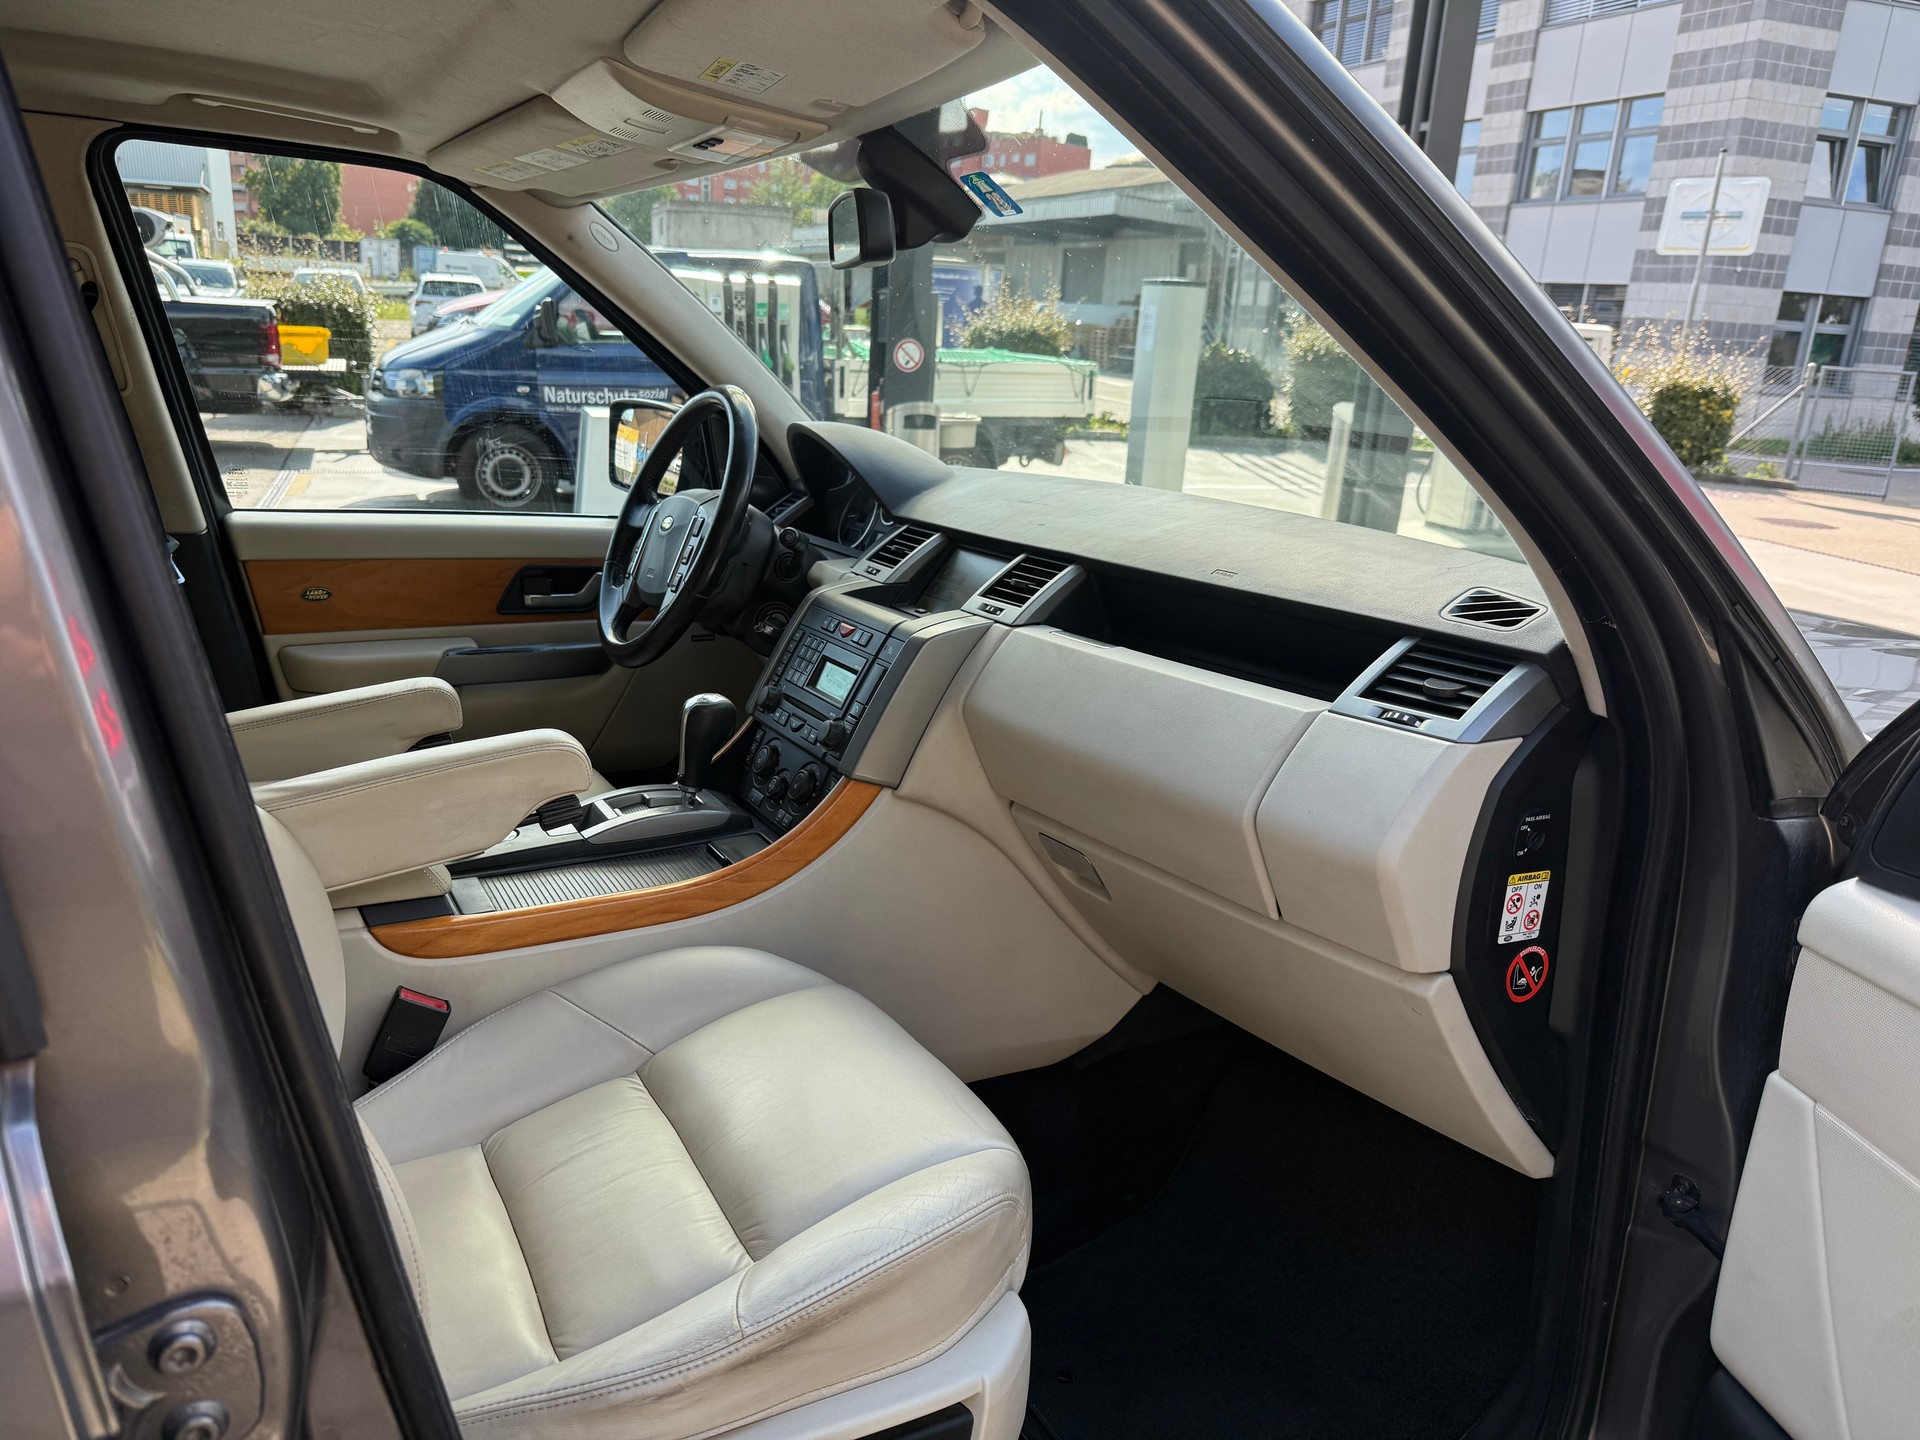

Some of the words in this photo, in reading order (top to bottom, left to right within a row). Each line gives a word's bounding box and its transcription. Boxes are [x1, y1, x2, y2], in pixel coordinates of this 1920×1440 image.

[1517, 873, 1541, 883] AIRBAG
[1511, 885, 1523, 893] OFF
[1519, 945, 1546, 957] AIRBAG
